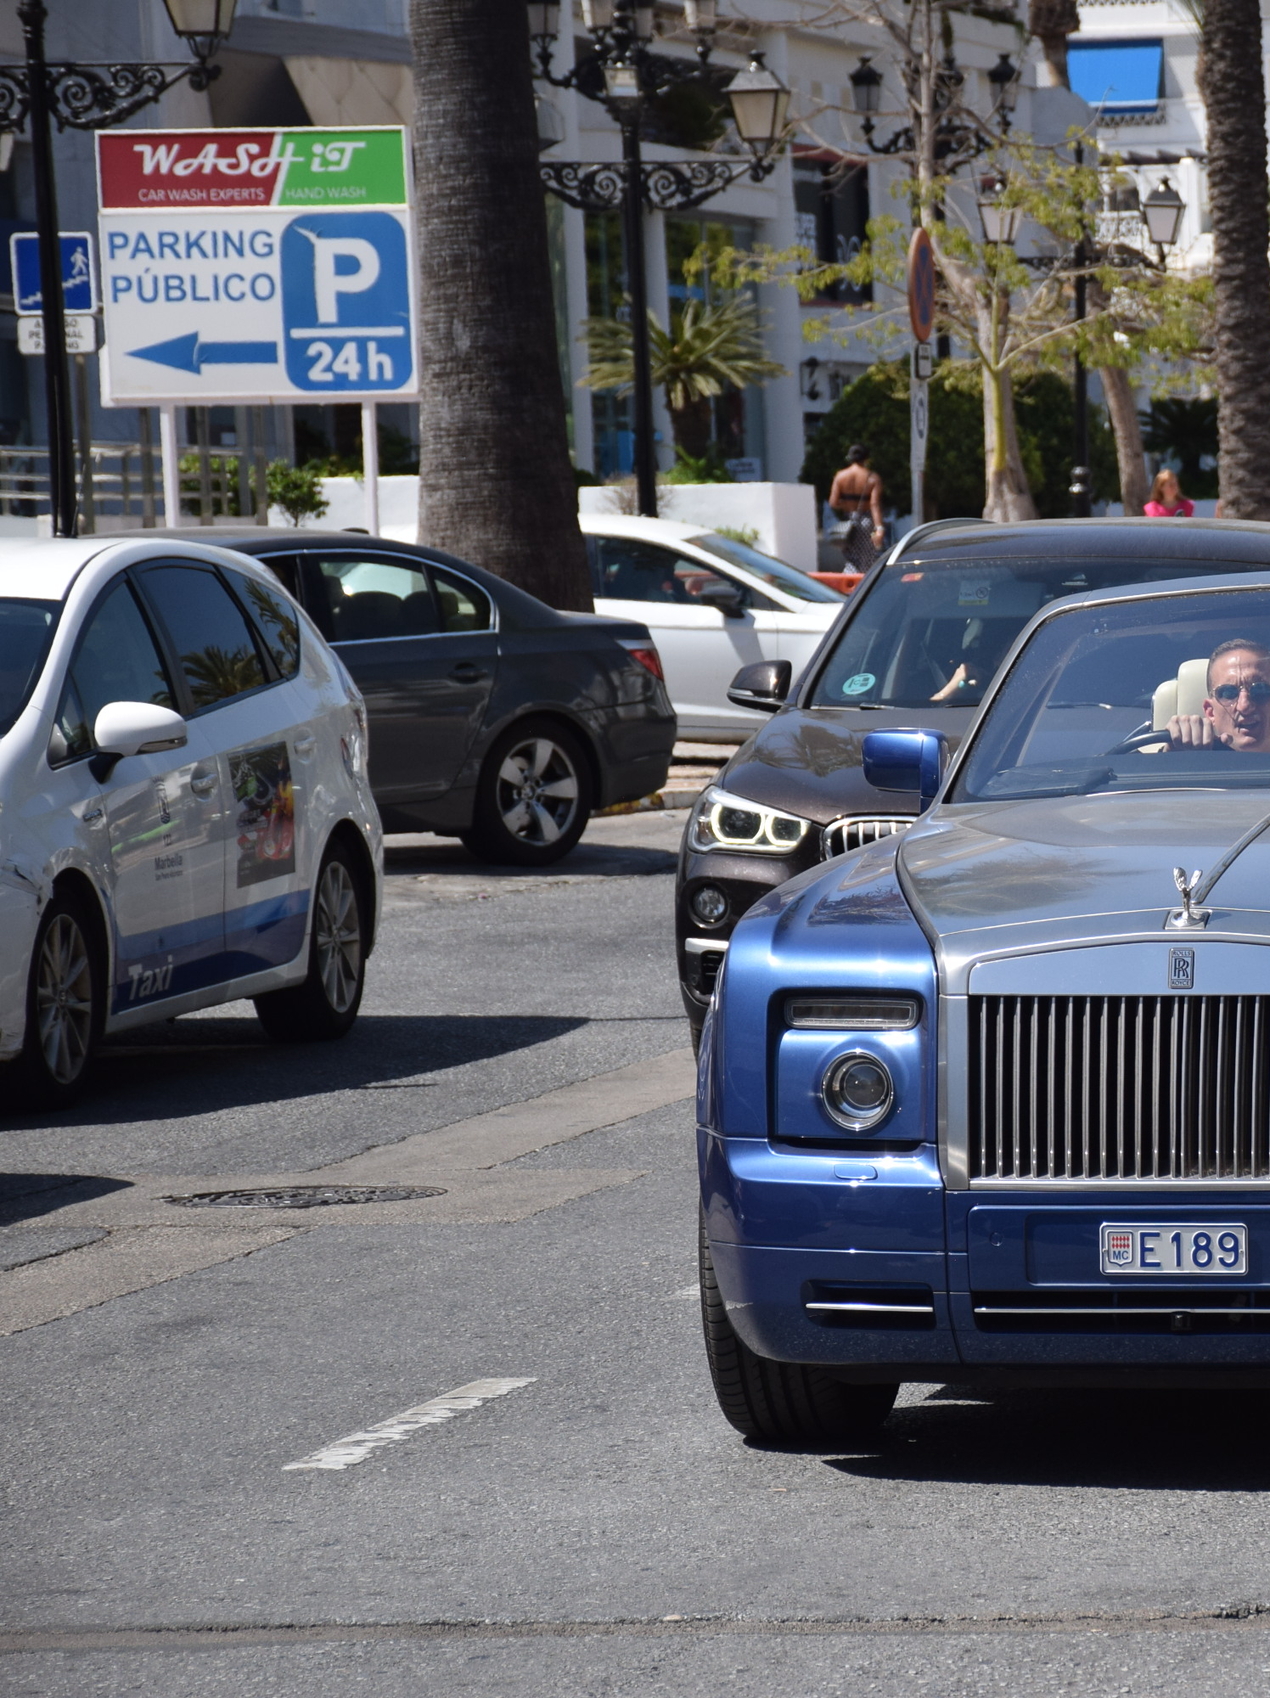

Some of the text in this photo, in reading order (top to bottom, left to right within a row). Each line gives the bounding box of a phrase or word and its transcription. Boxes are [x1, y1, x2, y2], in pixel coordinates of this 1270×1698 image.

[133, 142, 305, 177] WASH
[138, 187, 265, 202] CAR WASH EXPERTS
[285, 186, 366, 200] HAND WASH
[108, 229, 274, 259] PARKING
[111, 267, 275, 303] PÚBLICO
[312, 237, 381, 324] P
[128, 954, 174, 1001] Taxi
[1112, 1250, 1129, 1260] MC
[1138, 1230, 1240, 1268] E189
